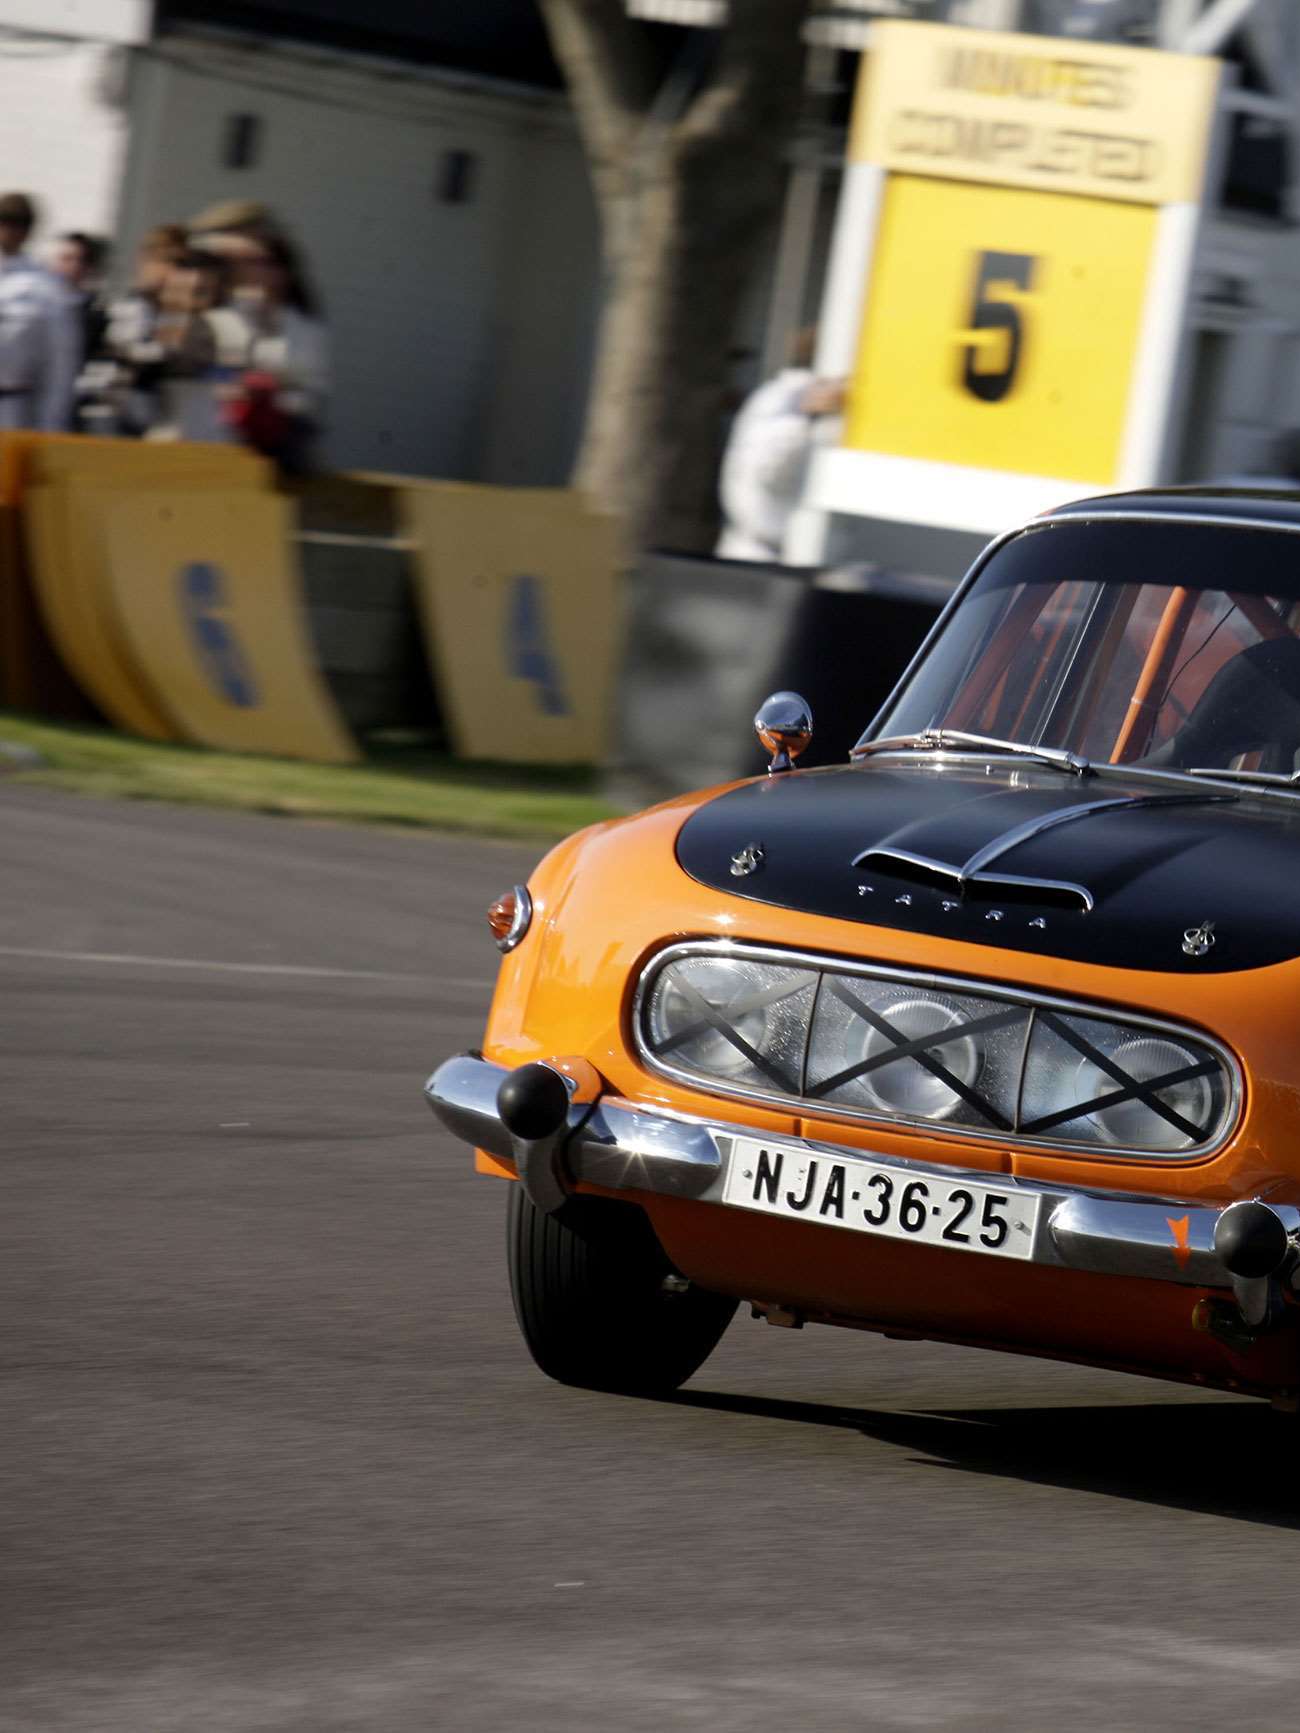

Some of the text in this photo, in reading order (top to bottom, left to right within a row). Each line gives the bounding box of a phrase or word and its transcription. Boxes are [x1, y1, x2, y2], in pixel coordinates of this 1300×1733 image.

[890, 110, 1160, 183] COMPLETED
[960, 249, 1039, 403] 5
[857, 885, 1047, 930] TATRA
